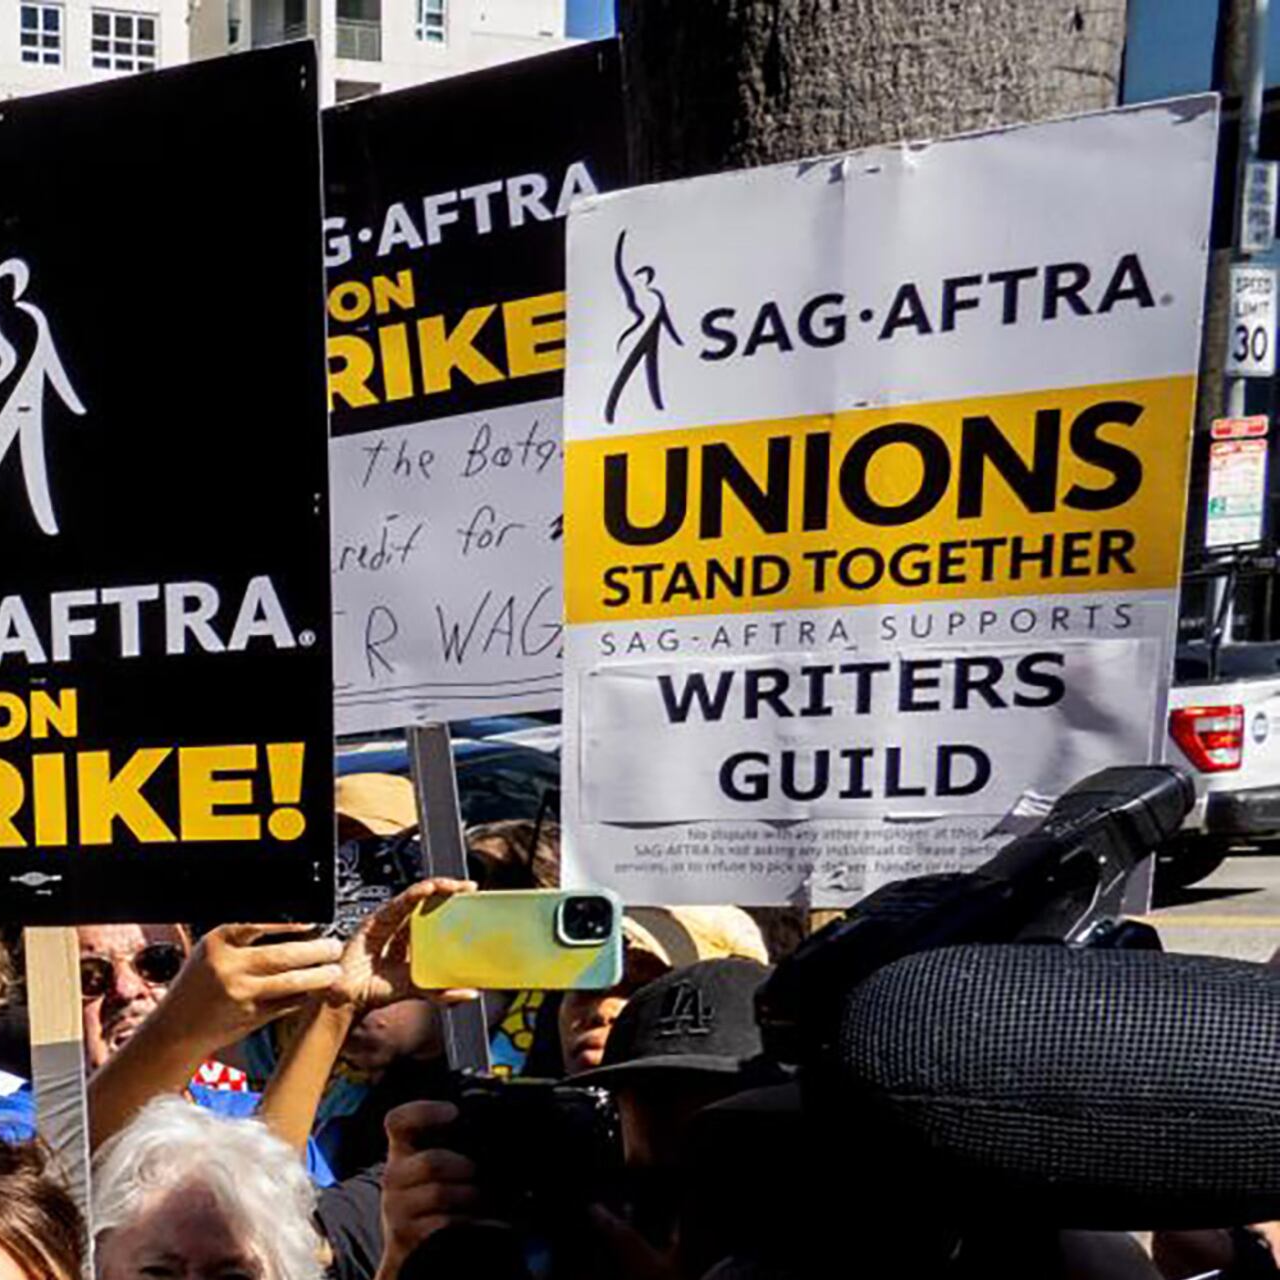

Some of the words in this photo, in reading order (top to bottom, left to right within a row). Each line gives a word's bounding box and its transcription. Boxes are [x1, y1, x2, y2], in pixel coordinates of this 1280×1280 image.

[327, 269, 415, 322] ON
[1235, 301, 1269, 317] LIMIT
[1233, 325, 1268, 362] 30
[604, 401, 1144, 547] UNIONS
[456, 504, 528, 557] for
[602, 555, 791, 607] STAND
[806, 529, 1136, 593] TOGETHER
[601, 617, 850, 657] SAG-AFTRA
[881, 603, 1133, 640] SUPPORTS
[657, 652, 1066, 724] WRITERS
[719, 743, 991, 801] GUILD
